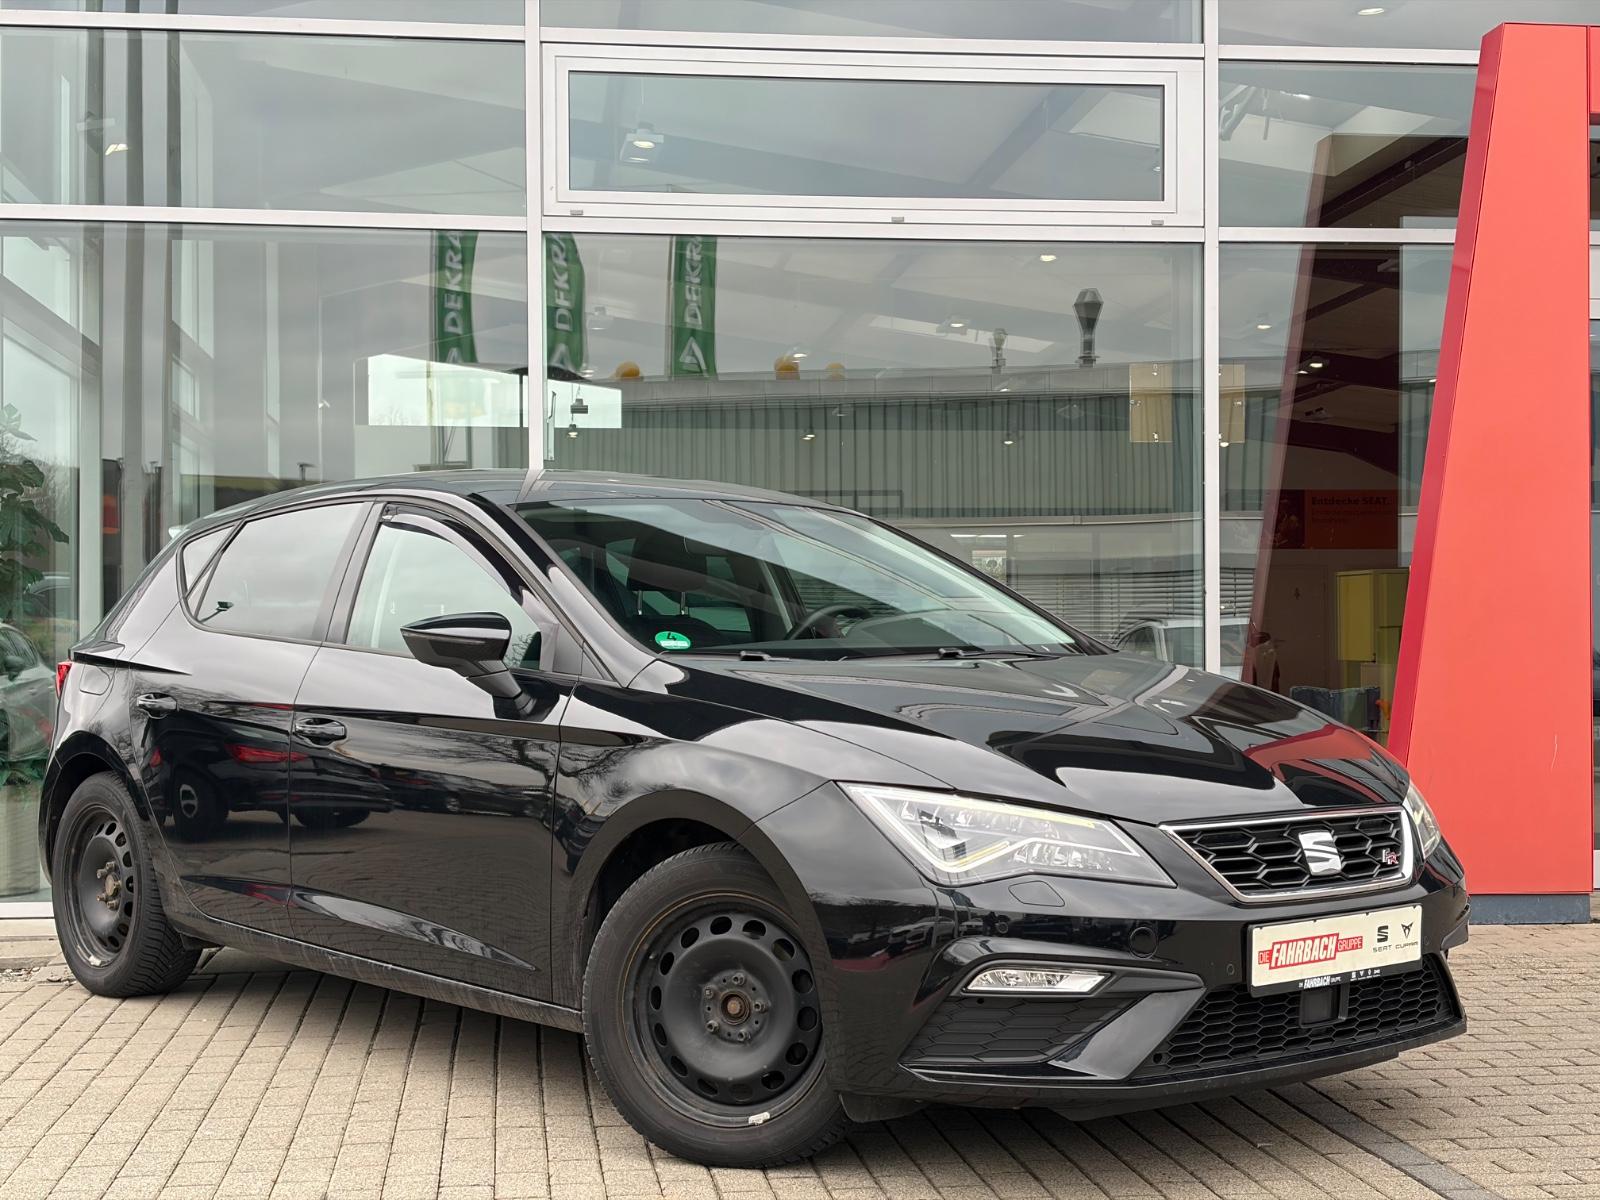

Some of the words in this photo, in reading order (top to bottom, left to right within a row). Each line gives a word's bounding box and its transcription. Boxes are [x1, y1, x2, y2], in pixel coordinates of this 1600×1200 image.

[1258, 951, 1270, 965] DIE
[1271, 935, 1338, 968] FAHRBACH
[1338, 937, 1363, 952] GRUPPE
[1372, 944, 1393, 953] SEAT
